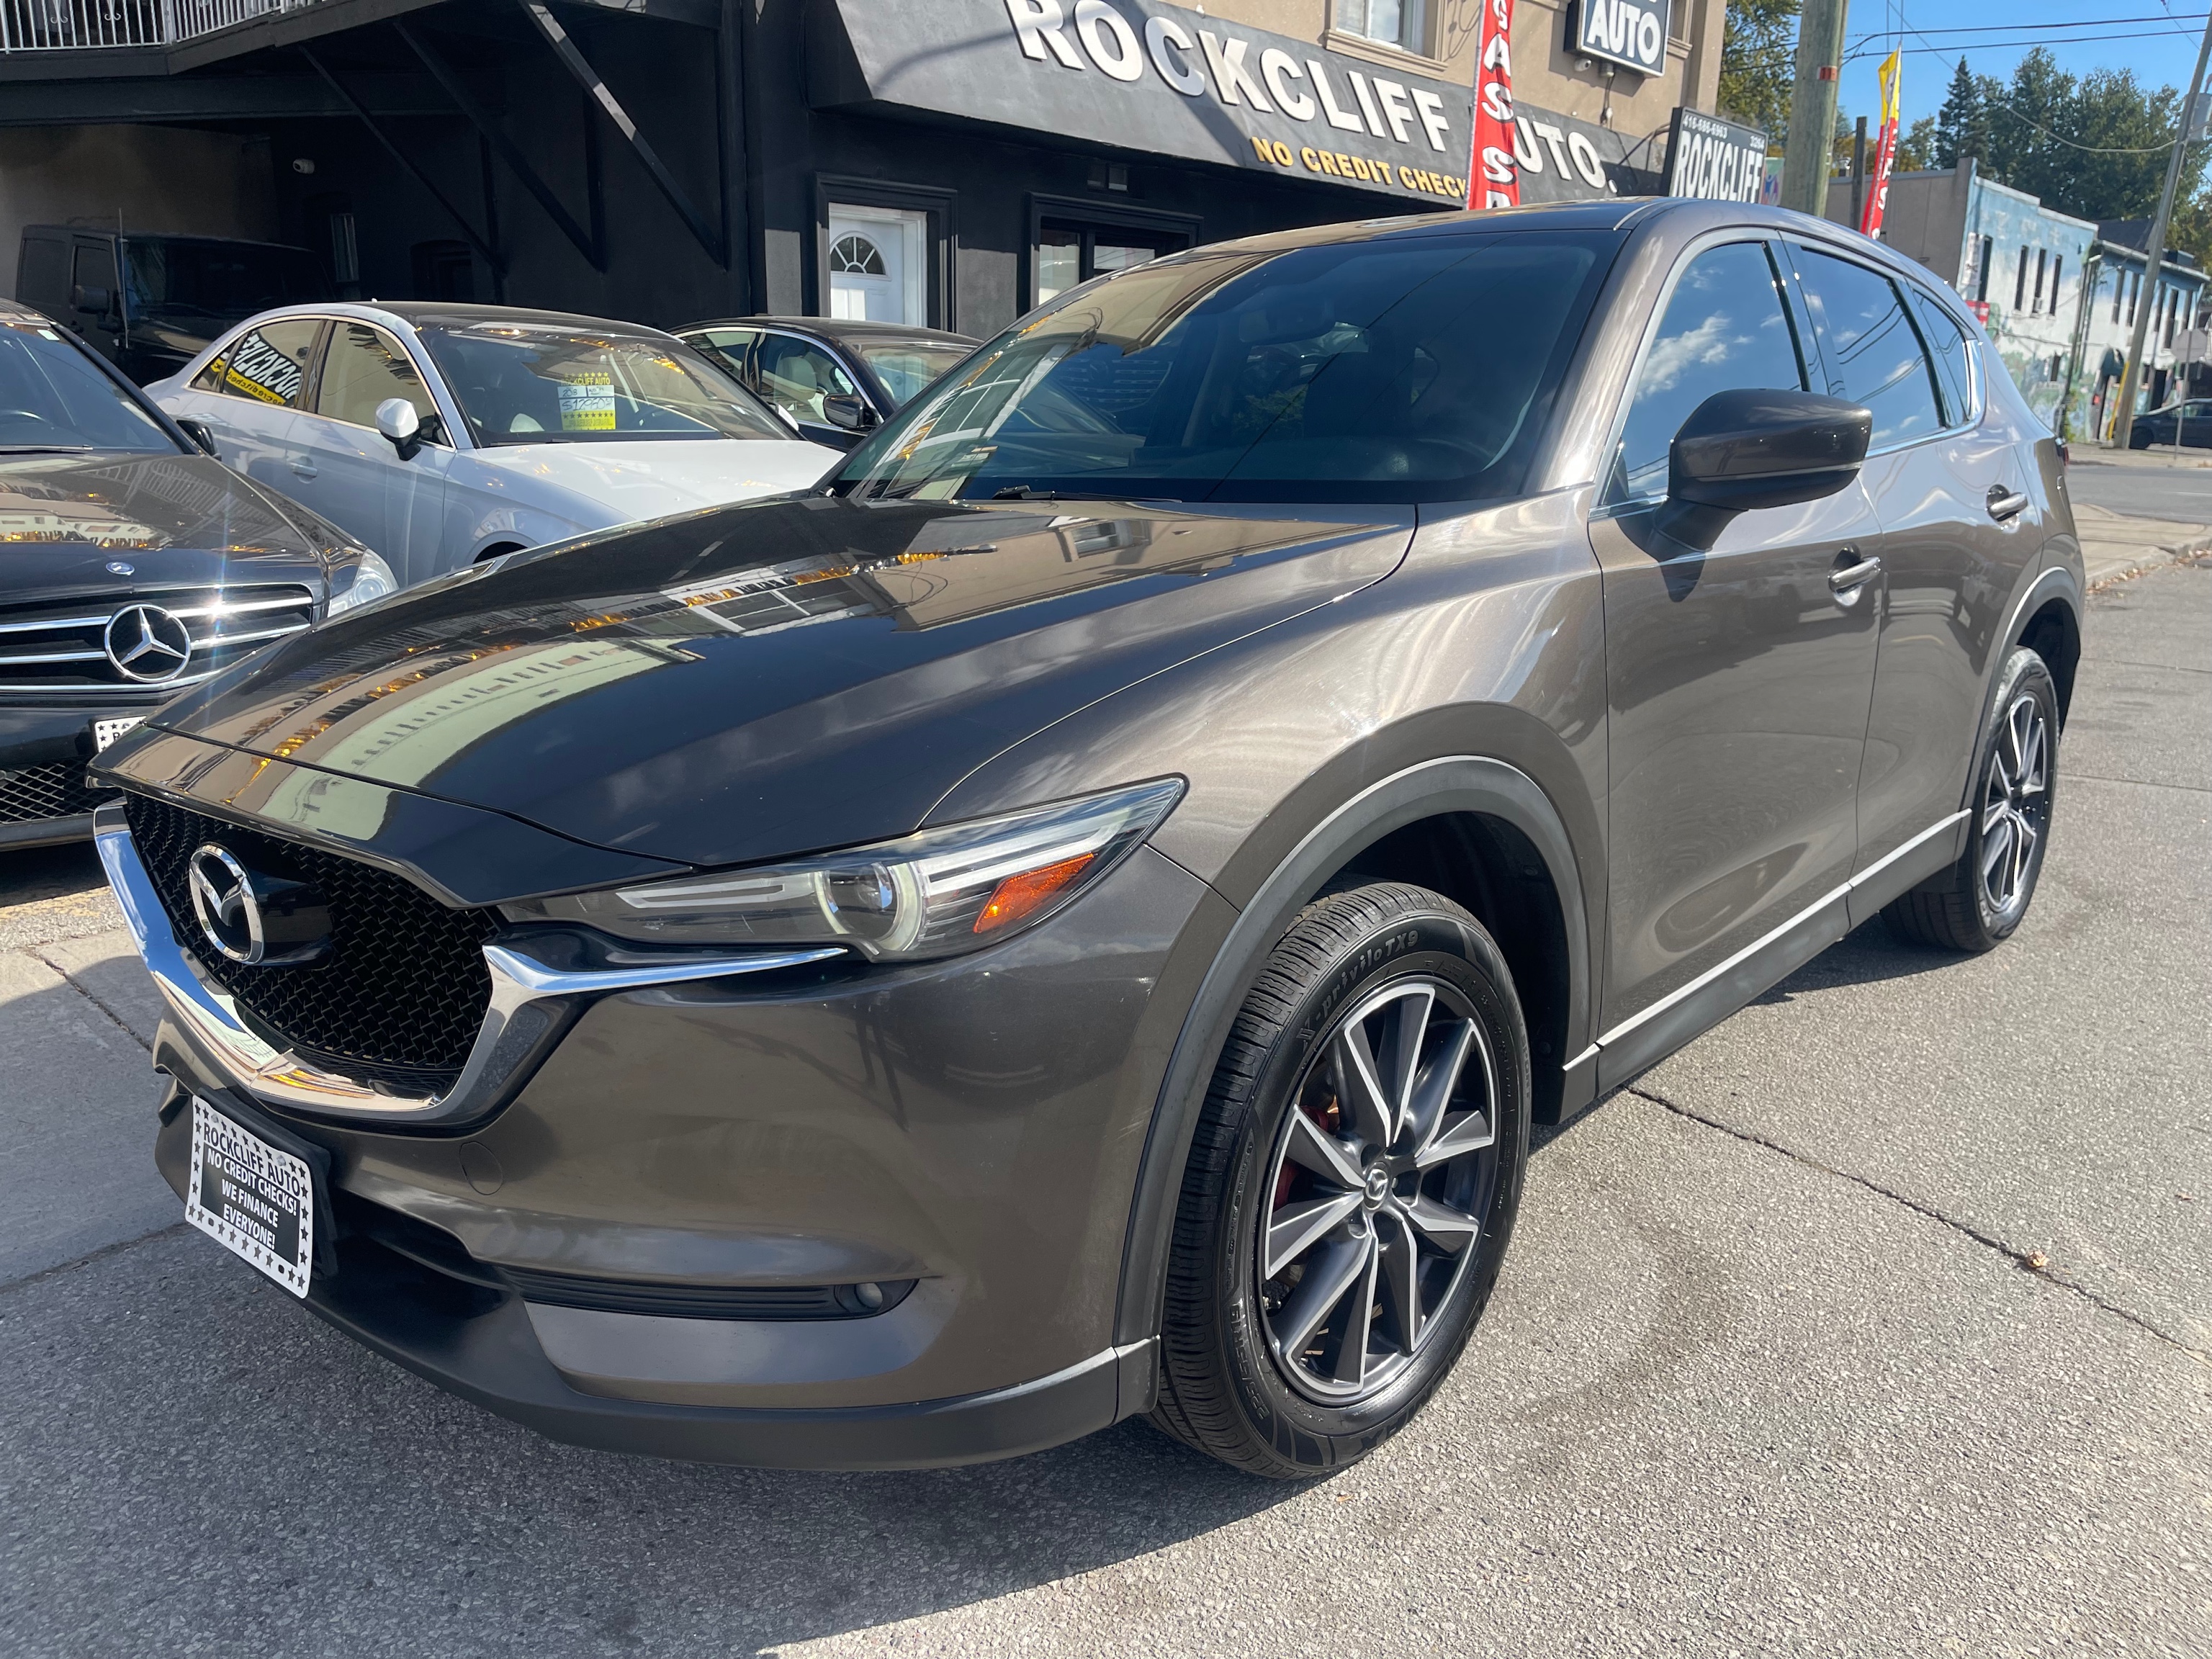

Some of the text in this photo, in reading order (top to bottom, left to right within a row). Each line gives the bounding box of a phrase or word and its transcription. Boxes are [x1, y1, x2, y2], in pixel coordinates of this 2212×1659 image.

[1586, 0, 1661, 64] AUTO
[1005, 0, 1449, 152] ROCKCLIFF
[1251, 136, 1293, 166] NO
[1300, 146, 1393, 185] CREDIT
[1671, 130, 1763, 204] ROCKCLIFF
[595, 377, 611, 385] AUTO
[204, 1121, 301, 1197] ROCKCLIFF AUTO
[207, 1148, 297, 1216] NO CREDIT CHECKS!
[222, 1179, 279, 1228] WE FINANCE
[223, 1203, 276, 1250] EVERYONE!
